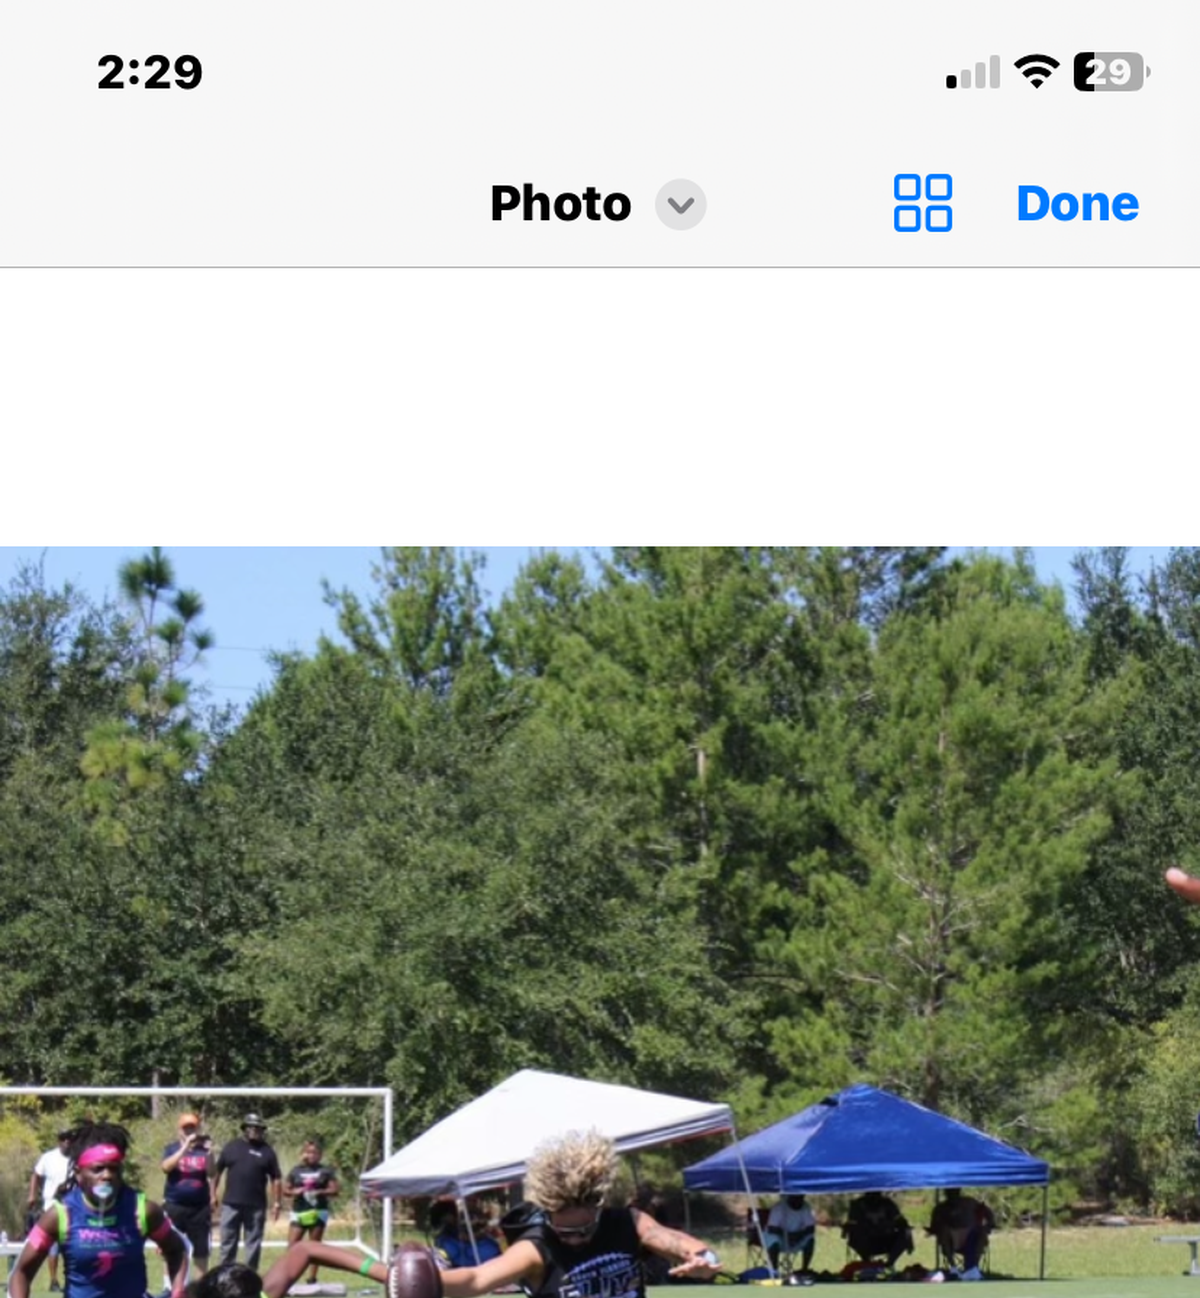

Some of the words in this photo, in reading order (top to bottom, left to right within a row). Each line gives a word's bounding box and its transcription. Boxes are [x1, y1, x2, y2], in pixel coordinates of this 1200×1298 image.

[97, 54, 203, 90] 2:29
[1085, 58, 1132, 86] 29
[492, 182, 632, 222] Photo
[1018, 184, 1140, 222] Done
